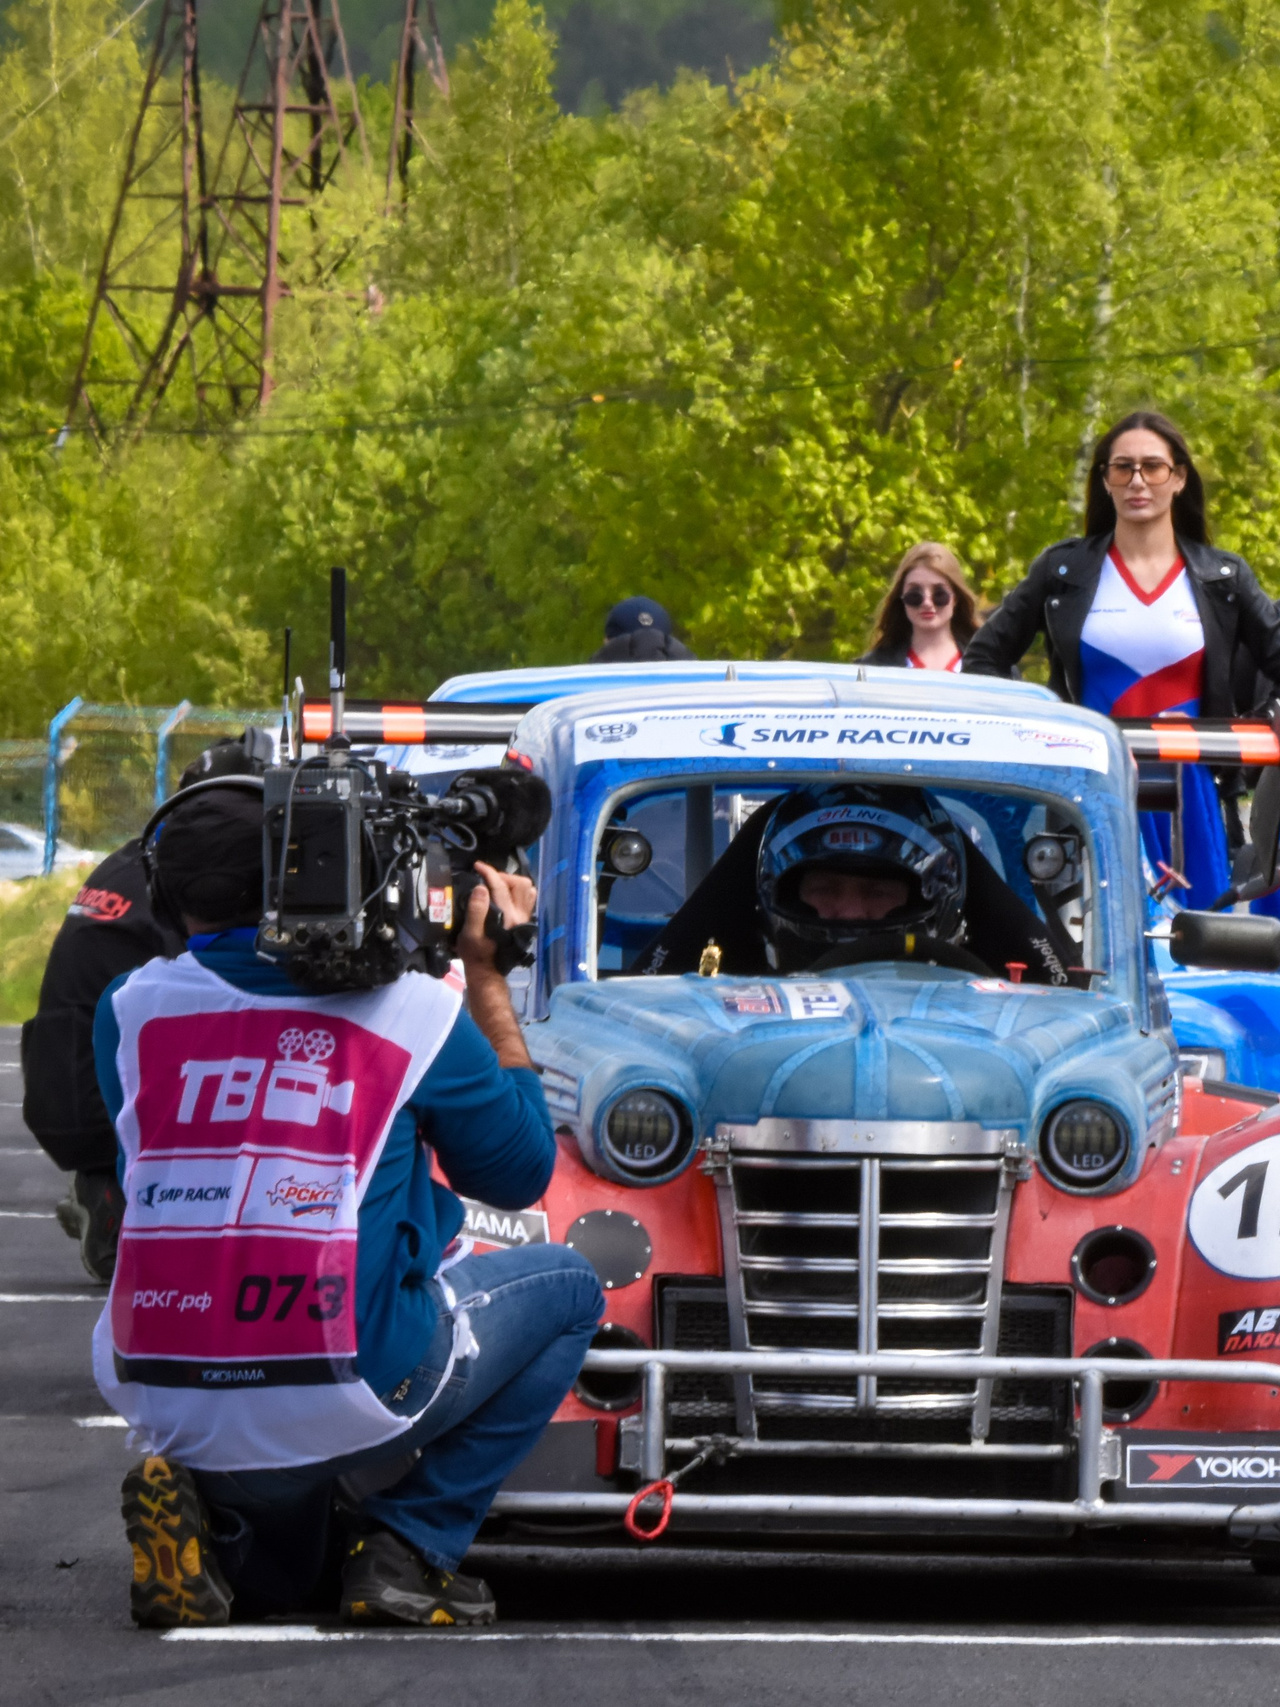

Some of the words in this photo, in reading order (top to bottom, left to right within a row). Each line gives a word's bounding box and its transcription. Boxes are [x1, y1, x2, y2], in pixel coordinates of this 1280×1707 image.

[774, 713, 836, 722] серия
[751, 728, 829, 743] SMP
[836, 729, 971, 746] RACING
[829, 831, 873, 845] BELL
[624, 1143, 656, 1159] LED
[1073, 1153, 1105, 1168] LED
[284, 1186, 333, 1201] РСКГ
[132, 1289, 212, 1312] РСКГ.рф
[234, 1275, 347, 1323] 073
[201, 1369, 266, 1382] YOKOHAMA
